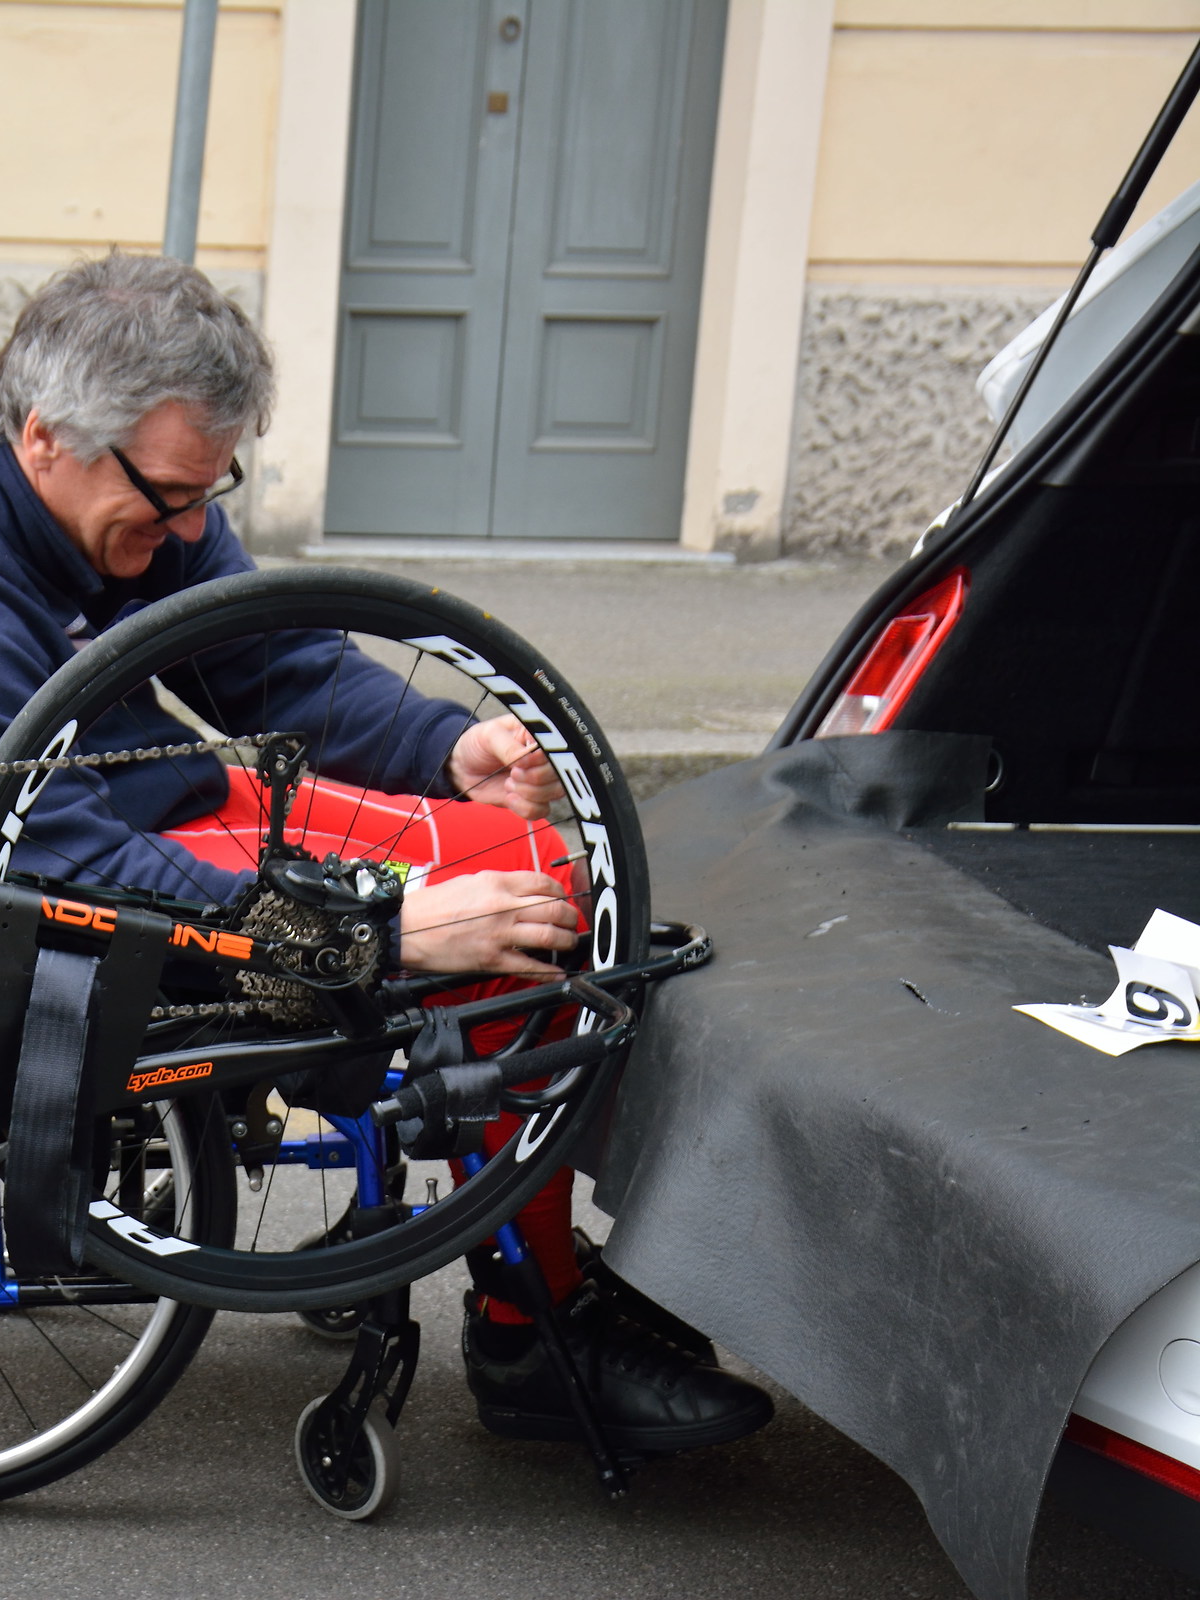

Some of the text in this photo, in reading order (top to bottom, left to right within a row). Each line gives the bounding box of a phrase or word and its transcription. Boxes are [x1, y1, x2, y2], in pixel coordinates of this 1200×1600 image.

[533, 668, 601, 757] Vittoria RUBINO PRO
